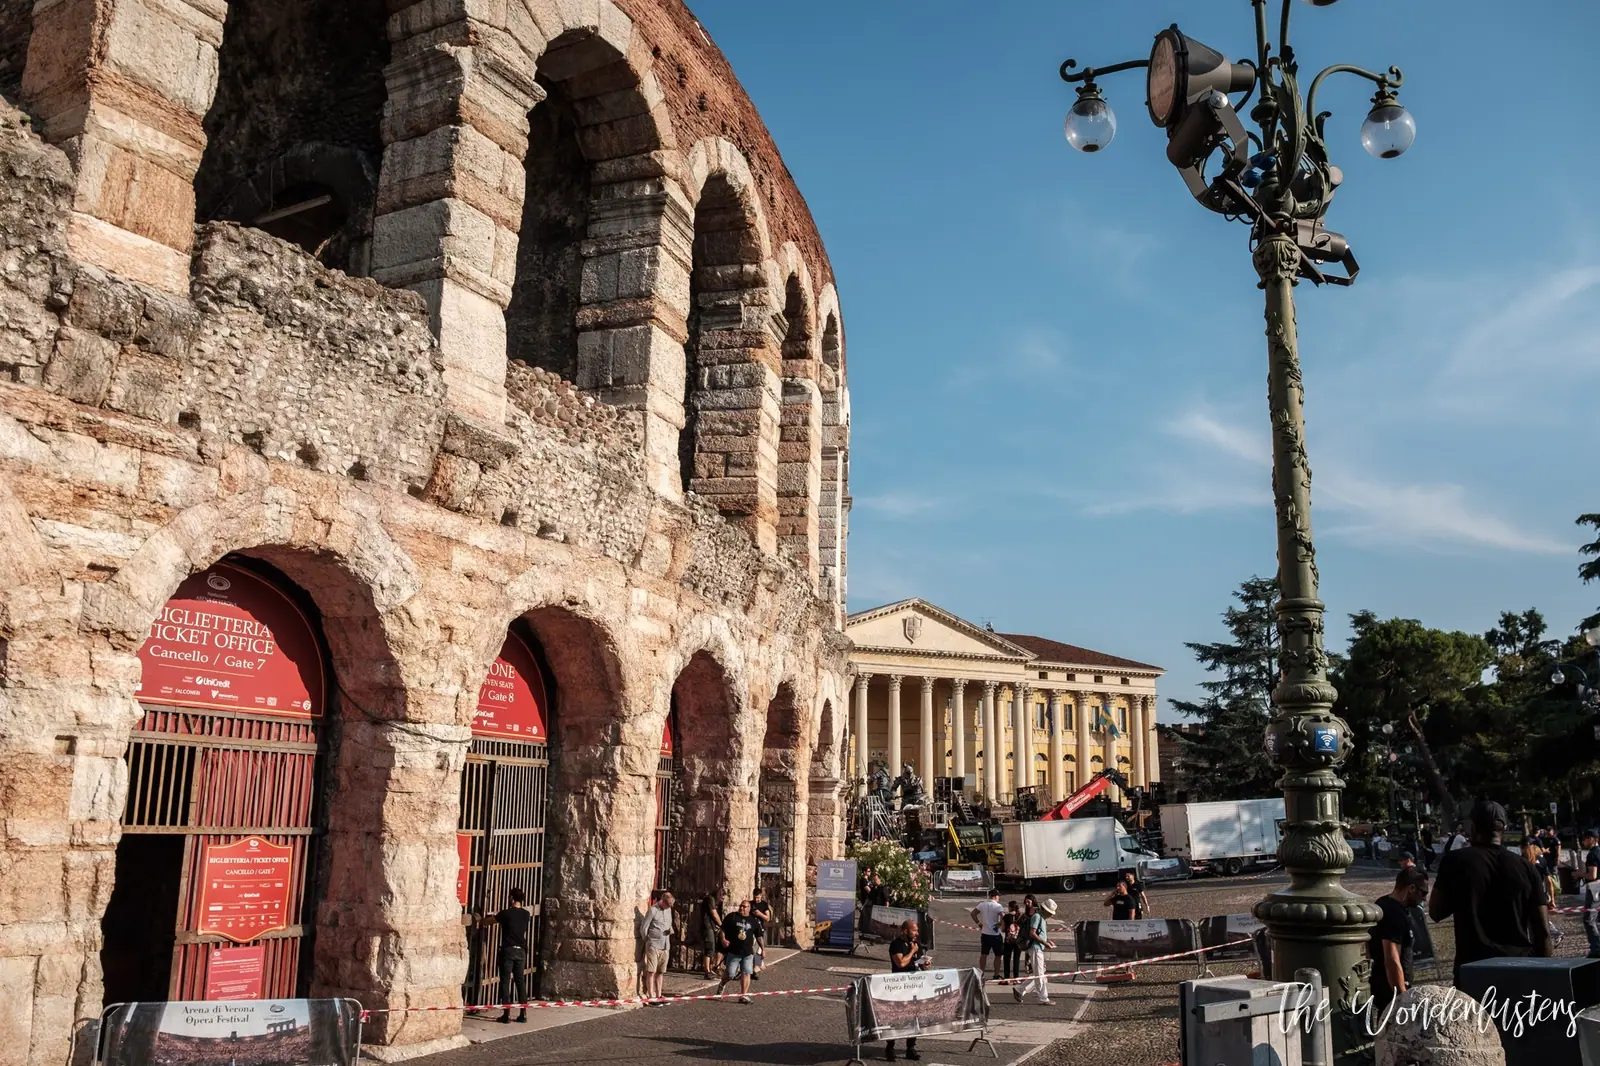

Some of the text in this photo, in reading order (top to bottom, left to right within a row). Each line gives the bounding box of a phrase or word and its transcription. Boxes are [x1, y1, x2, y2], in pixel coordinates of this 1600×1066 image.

[214, 632, 275, 655] OFFICE
[149, 645, 209, 663] Cancello
[224, 656, 254, 670] Gate
[257, 659, 266, 670] 7
[203, 678, 231, 688] UniCredit
[499, 680, 514, 689] SEATS
[488, 690, 507, 702] Gate
[508, 692, 514, 703] 8
[884, 984, 902, 992] Opera
[182, 1005, 255, 1014] Arena di Verona
[185, 1014, 249, 1026] Opera Festival
